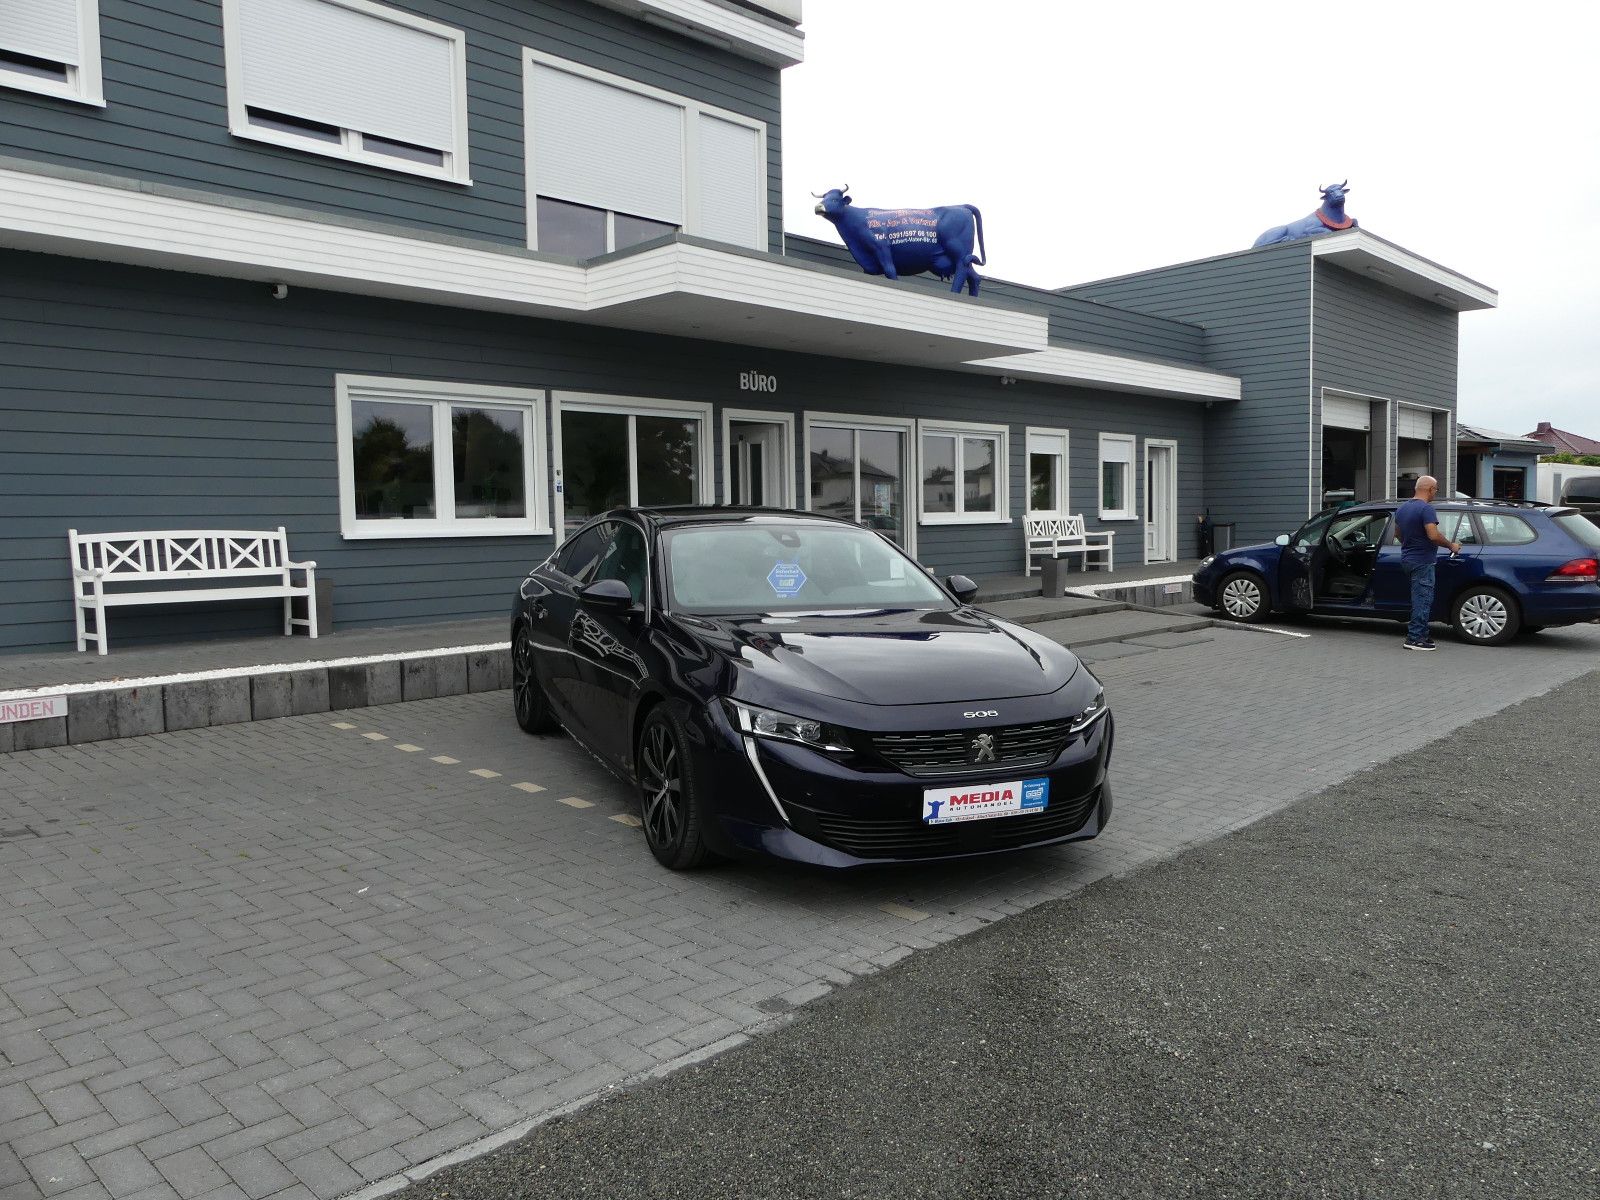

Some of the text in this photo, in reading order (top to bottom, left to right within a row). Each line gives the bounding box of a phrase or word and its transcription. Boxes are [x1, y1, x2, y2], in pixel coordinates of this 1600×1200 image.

[740, 370, 777, 393] BÜRO
[963, 710, 999, 719] 508
[949, 790, 1013, 806] MEDIA
[949, 801, 1013, 811] AUTOHANDEL
